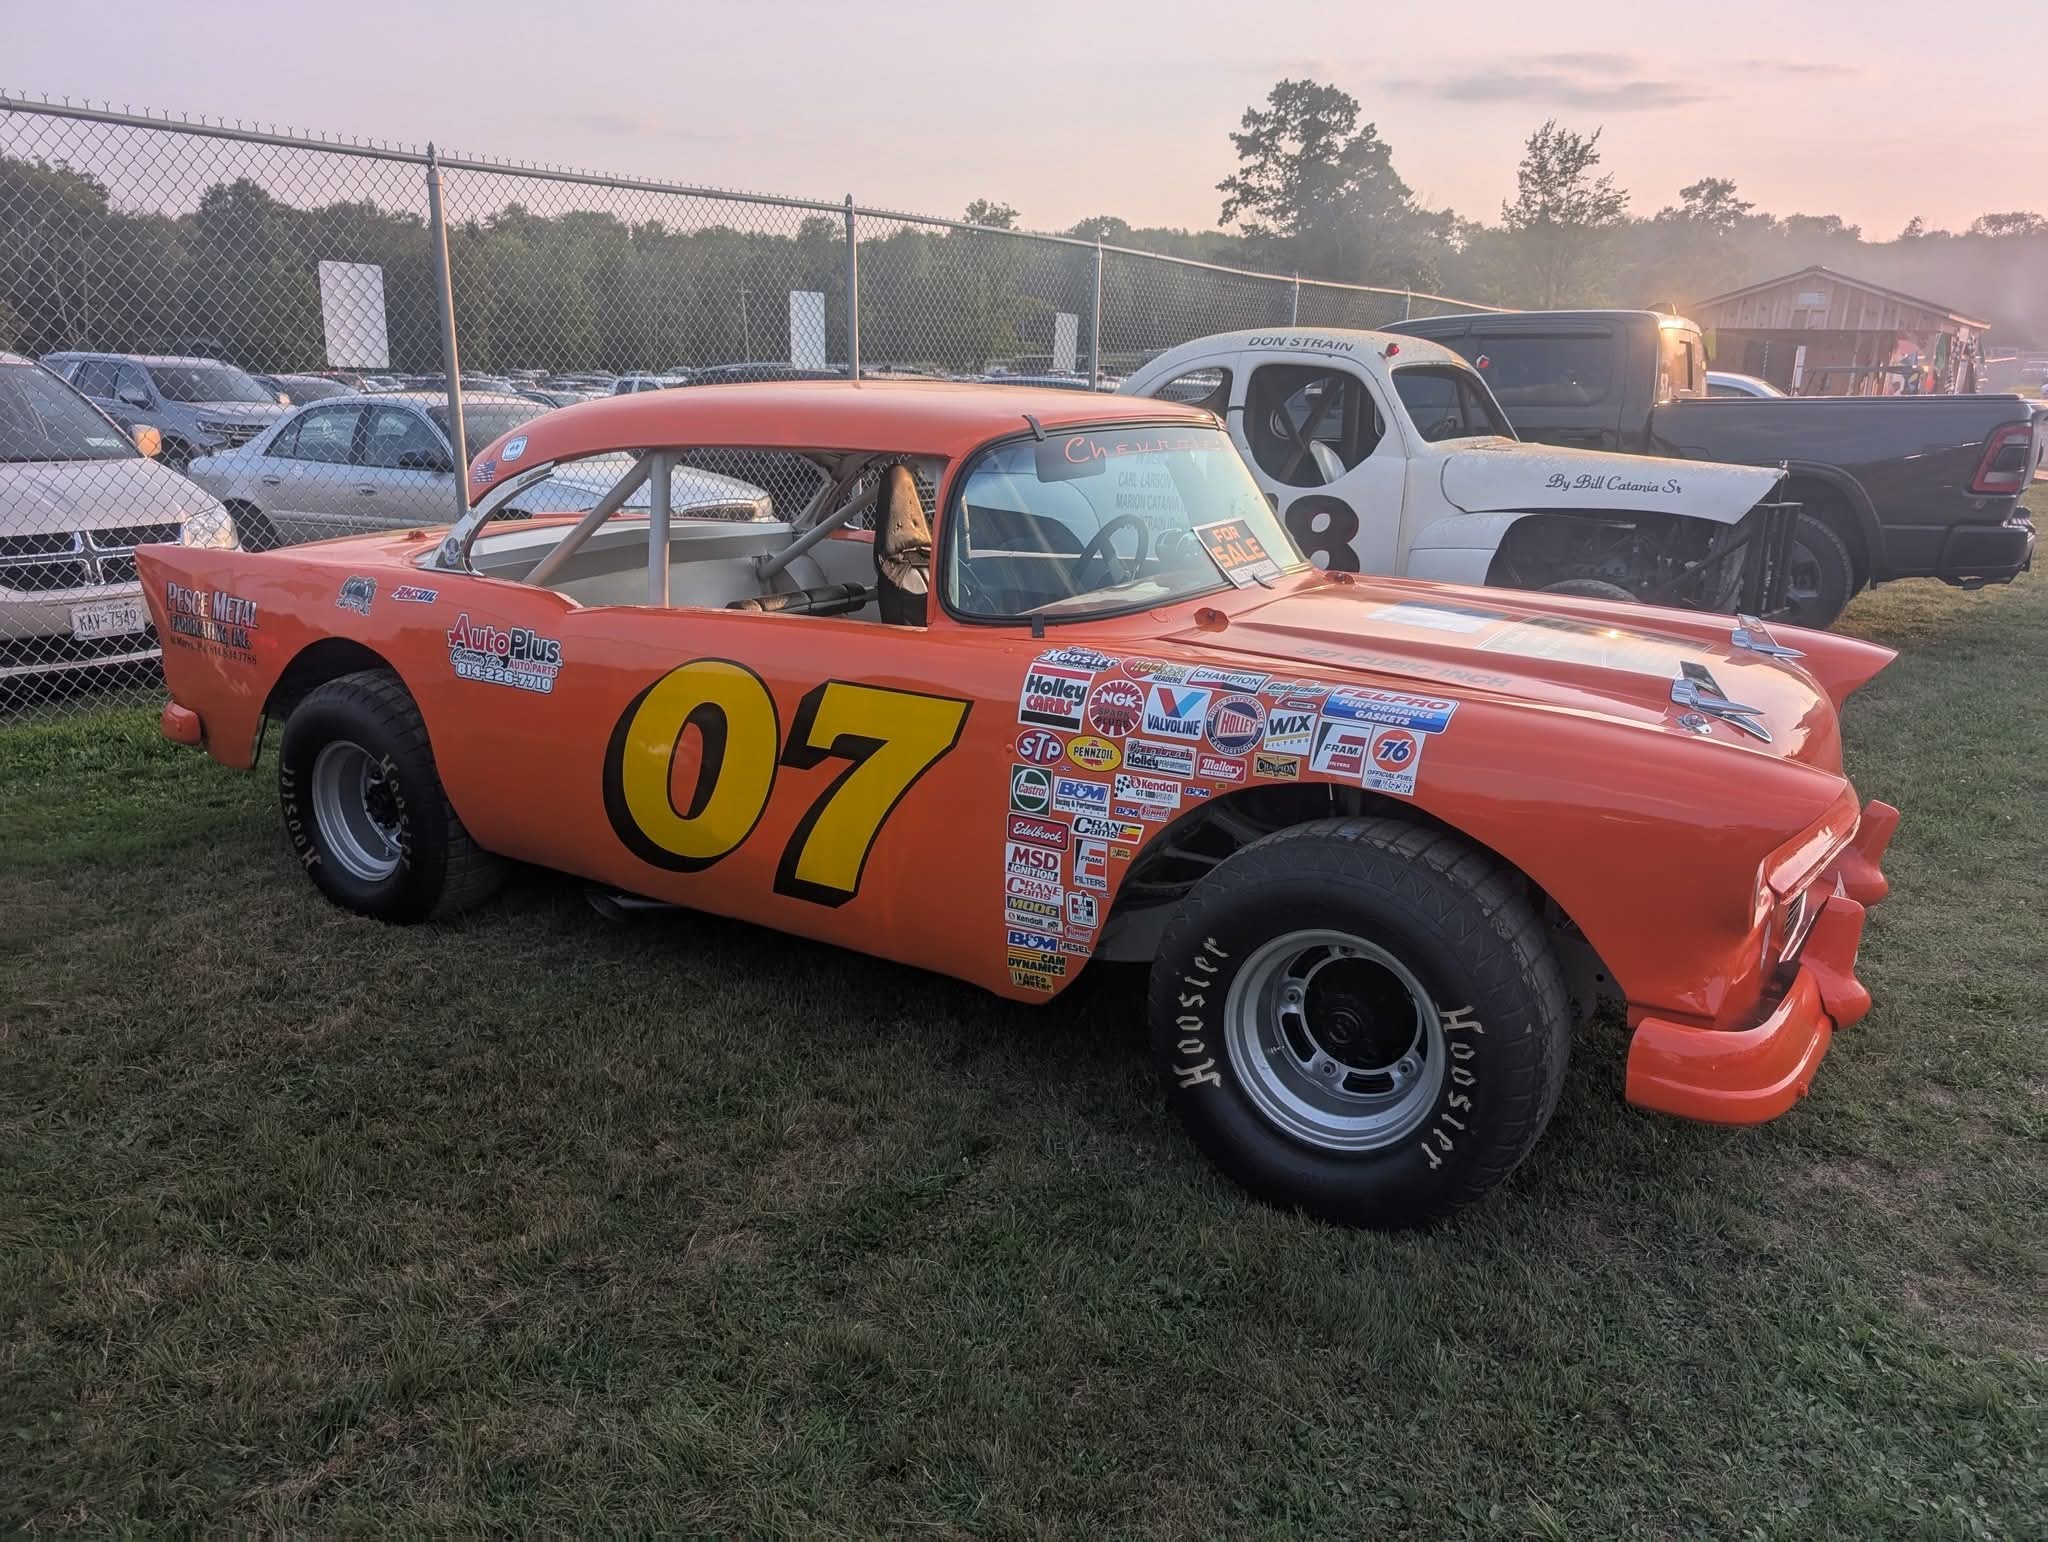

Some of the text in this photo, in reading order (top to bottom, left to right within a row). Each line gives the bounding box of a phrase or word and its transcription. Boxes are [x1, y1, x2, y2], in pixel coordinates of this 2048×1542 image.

[1248, 336, 1354, 352] DON STRAIN
[1545, 473, 1682, 494] By Bill Catania Sr
[1212, 526, 1240, 543] FOR
[1211, 537, 1267, 569] SALE
[167, 581, 260, 629] PESCE METAL
[456, 662, 552, 691] 814-226-7710
[509, 660, 558, 676] AUTO PARTS
[1438, 668, 1513, 687] INCH
[1195, 670, 1260, 686] CHAMPION
[1025, 674, 1088, 707] Holley
[1101, 691, 1137, 708] NGK
[1025, 694, 1073, 716] CARBS
[1338, 699, 1436, 719] PERFORMANCE
[1147, 713, 1201, 736] VALVOLINE
[1221, 711, 1256, 734] HOLLEY
[1269, 714, 1314, 736] WIX
[1354, 710, 1412, 726] GASKETS
[1020, 732, 1061, 761] STP
[1265, 738, 1310, 748] FILTERS
[1379, 739, 1413, 763] 76
[1073, 746, 1113, 760] PENNZOIL
[1127, 753, 1159, 769] Holley
[1202, 758, 1244, 775] Mallory
[1256, 756, 1298, 777] CHAMPION
[1367, 769, 1414, 782] OFFICIAL FUEL
[602, 656, 975, 909] 07
[1018, 783, 1047, 798] Castrol
[1058, 780, 1106, 801] B&M
[1141, 779, 1179, 793] Kendall
[1013, 821, 1063, 843] Edelbrock
[1011, 846, 1059, 871] MSD
[1010, 863, 1058, 881] IGNITION
[1075, 875, 1106, 888] FILTERS
[1008, 897, 1058, 916] MOOG
[1016, 913, 1043, 926] Kendall
[1009, 931, 1058, 952] B&M
[1061, 942, 1091, 954] JESEL
[1008, 957, 1065, 976] DYNAMICS
[1041, 954, 1066, 965] CAM
[1172, 935, 1230, 1089] Hoosier
[1420, 1004, 1486, 1170] Hoosier
